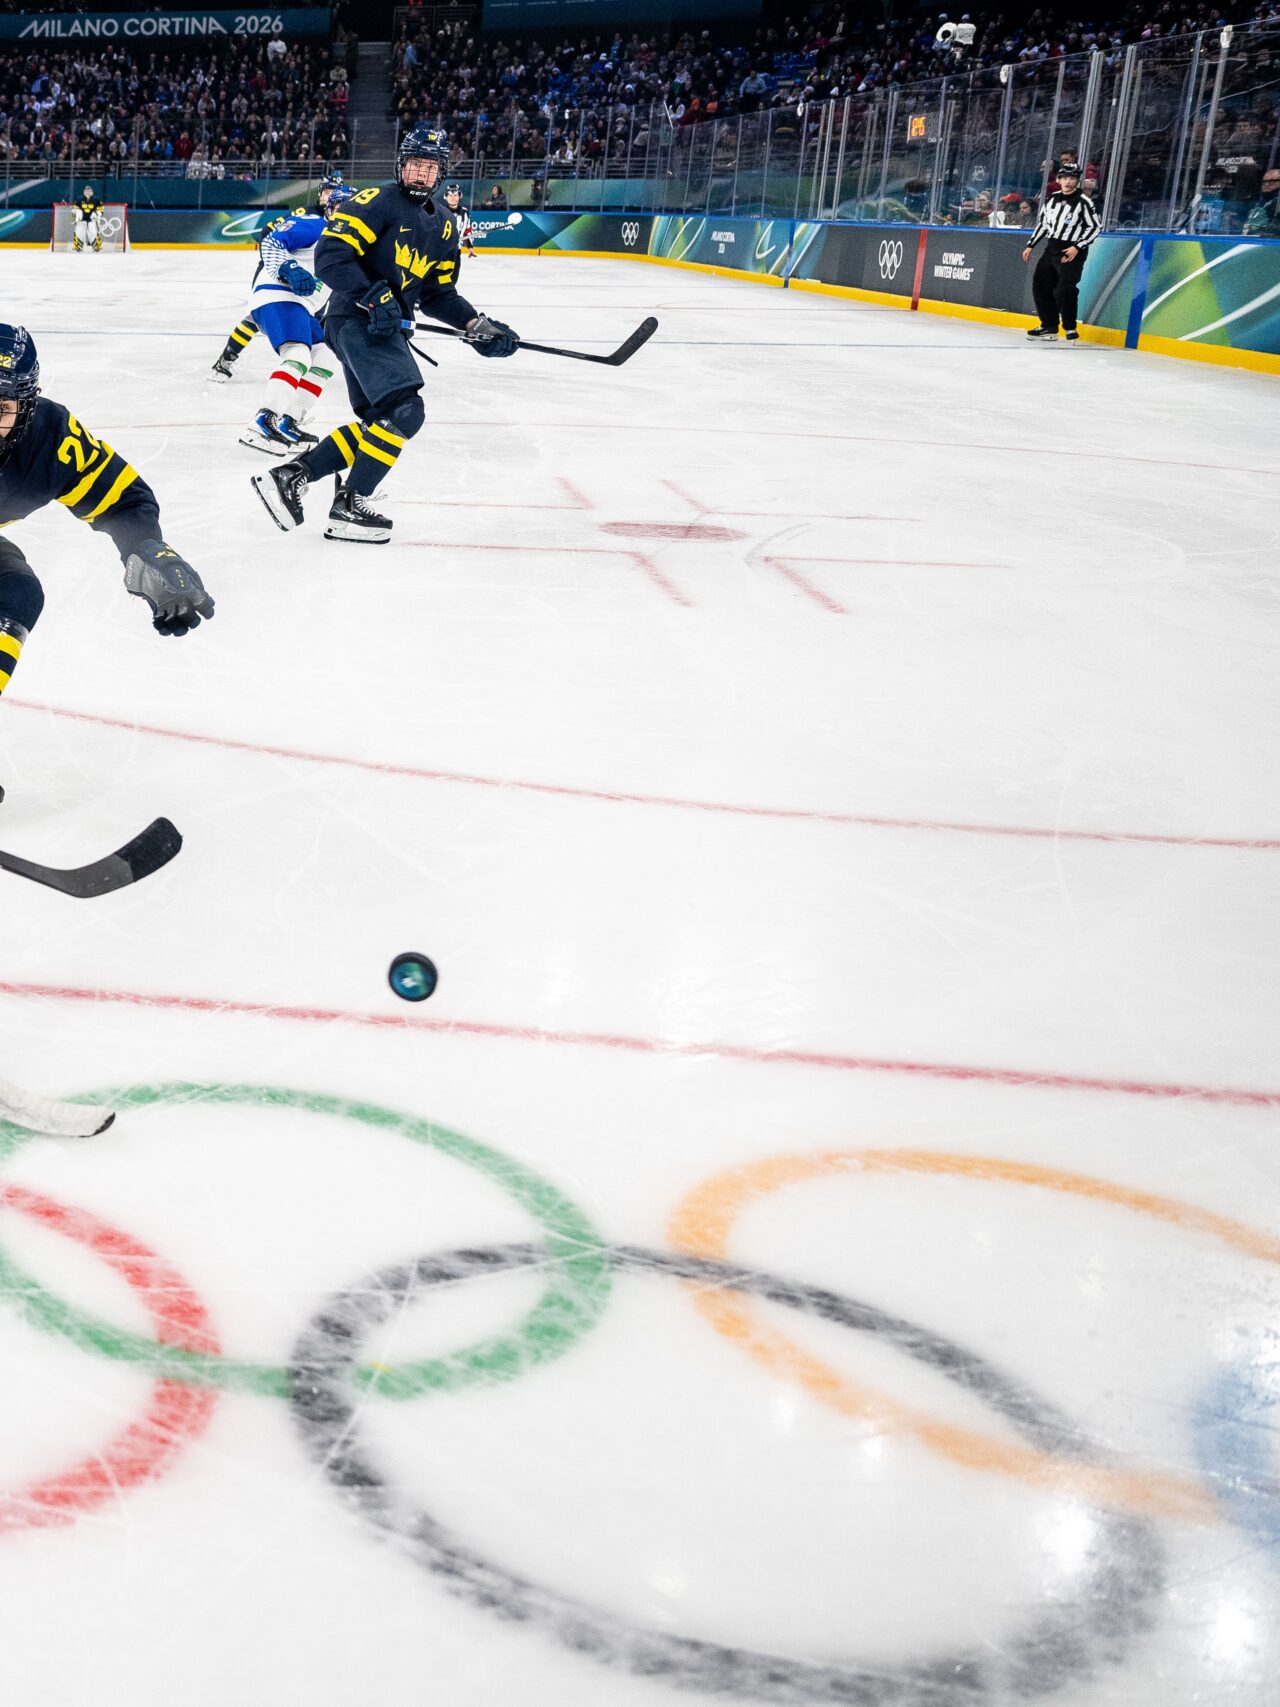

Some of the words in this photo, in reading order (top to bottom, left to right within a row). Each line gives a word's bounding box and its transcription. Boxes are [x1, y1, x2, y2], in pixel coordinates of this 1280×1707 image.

[18, 19, 119, 38] MILANO
[123, 16, 228, 37] CORTINA
[233, 15, 284, 34] 2026
[442, 219, 454, 241] A
